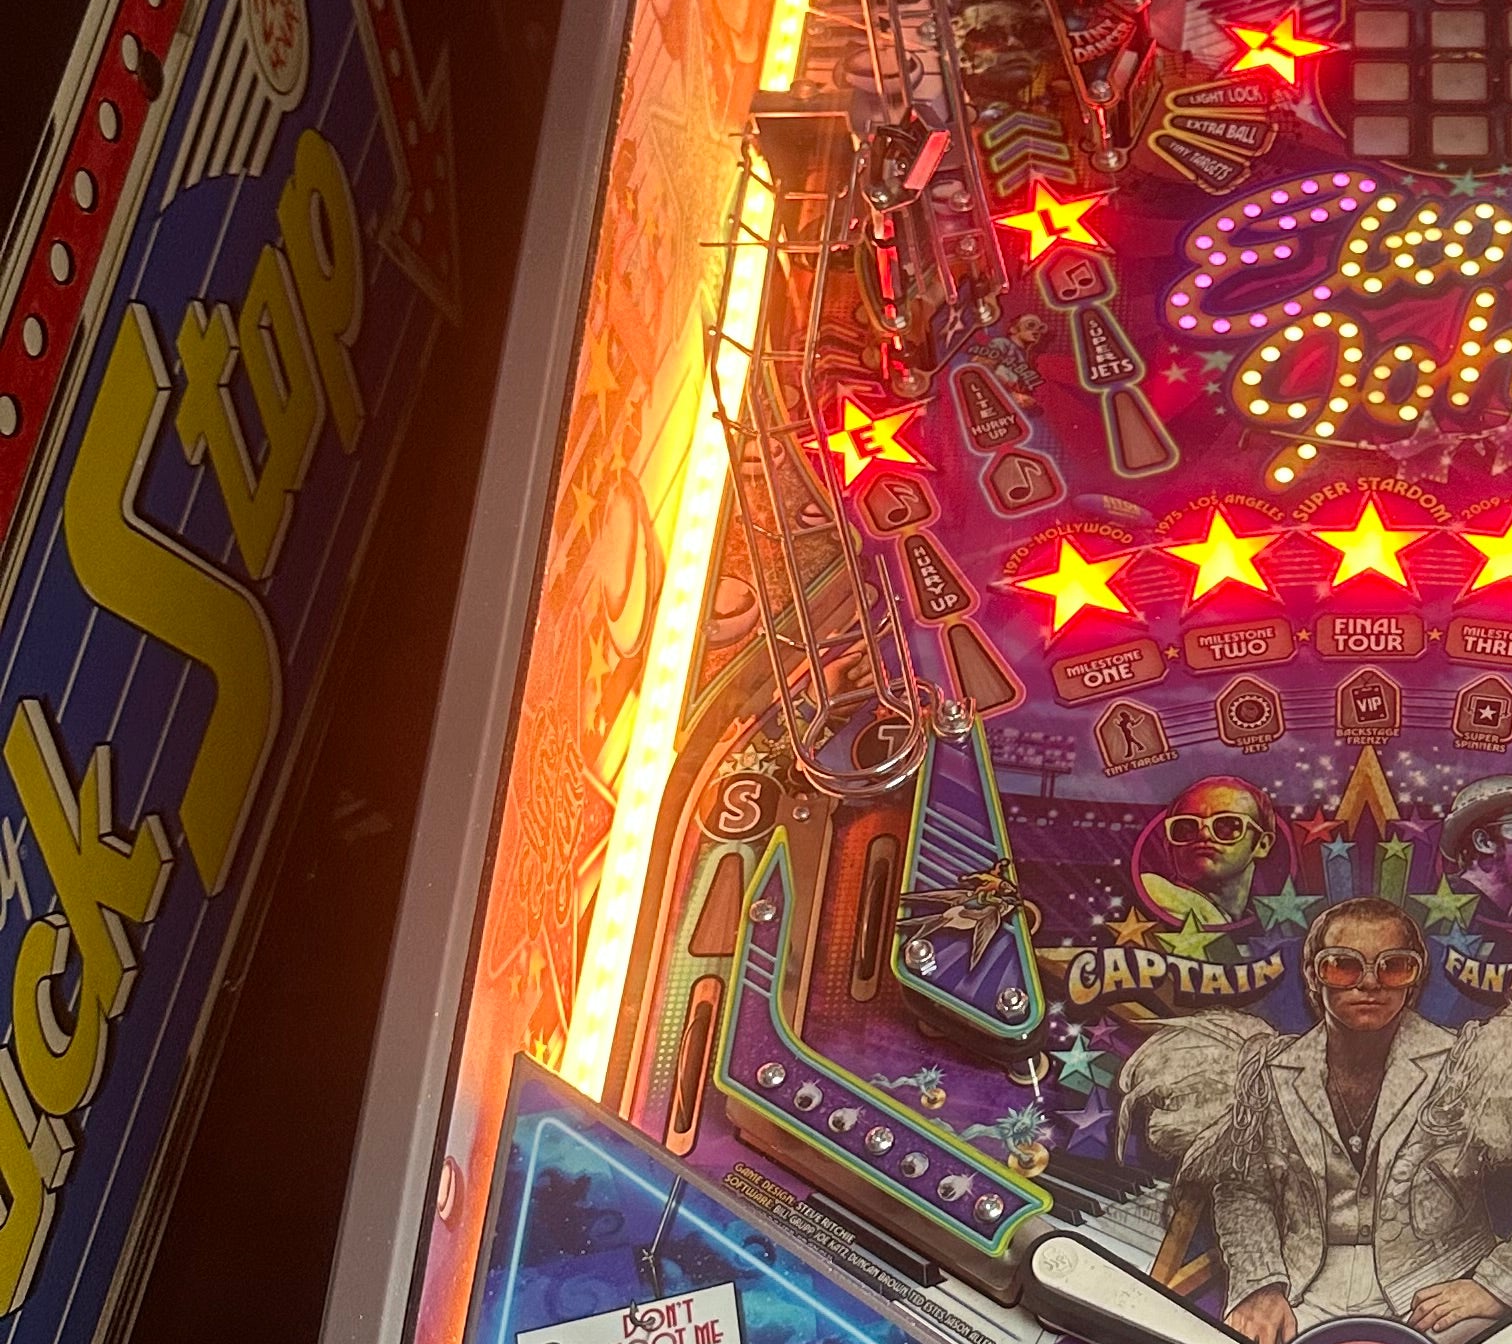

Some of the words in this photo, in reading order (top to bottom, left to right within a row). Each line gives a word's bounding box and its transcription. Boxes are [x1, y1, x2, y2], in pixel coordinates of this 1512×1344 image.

[1068, 18, 1117, 45] TINY
[1189, 88, 1226, 105] LIGHT
[1228, 85, 1263, 103] LOCK
[1186, 119, 1224, 135] EXTRA
[1225, 123, 1256, 144] BALL
[1169, 142, 1192, 157] TINY
[1188, 149, 1233, 181] TARGETS
[1039, 209, 1069, 237] L
[1089, 358, 1135, 381] JETS
[971, 415, 1016, 437] HURRY
[988, 427, 1008, 440] UP
[855, 429, 883, 459] E
[1292, 481, 1351, 522] SUPER
[1356, 476, 1453, 524] STARDOM
[1460, 497, 1501, 521] 2009
[63, 125, 368, 901] Stop
[1155, 510, 1184, 535] 1975
[1188, 493, 1218, 511] LOS
[1224, 493, 1287, 523] ANGELES
[1004, 546, 1030, 575] 1970
[1033, 522, 1135, 545] HOLLYWOOD
[930, 591, 959, 612] UP
[1198, 627, 1276, 647] MILESTONE
[1333, 617, 1404, 635] FINAL
[1210, 640, 1267, 661] TWO
[1333, 635, 1405, 653] TOUR
[1065, 649, 1143, 679] MILESTONE
[1082, 665, 1135, 689] ONE
[1355, 696, 1383, 713] VIP
[1235, 734, 1273, 746] SUPER
[1335, 727, 1401, 738] BACKSTAGE
[1346, 735, 1390, 746] FRENZY
[1462, 732, 1500, 743] SUPER
[1242, 742, 1270, 754] JETS
[1452, 739, 1507, 754] SPINNERS
[1104, 762, 1131, 778] TINY
[1130, 750, 1180, 774] TARGETS
[718, 778, 763, 834] S
[1066, 945, 1286, 1005] CAPTAIN
[734, 1162, 764, 1186] GAME
[797, 1202, 823, 1224] STEVE
[820, 1216, 856, 1244] RITCHIE
[622, 1298, 694, 1339] DON'T
